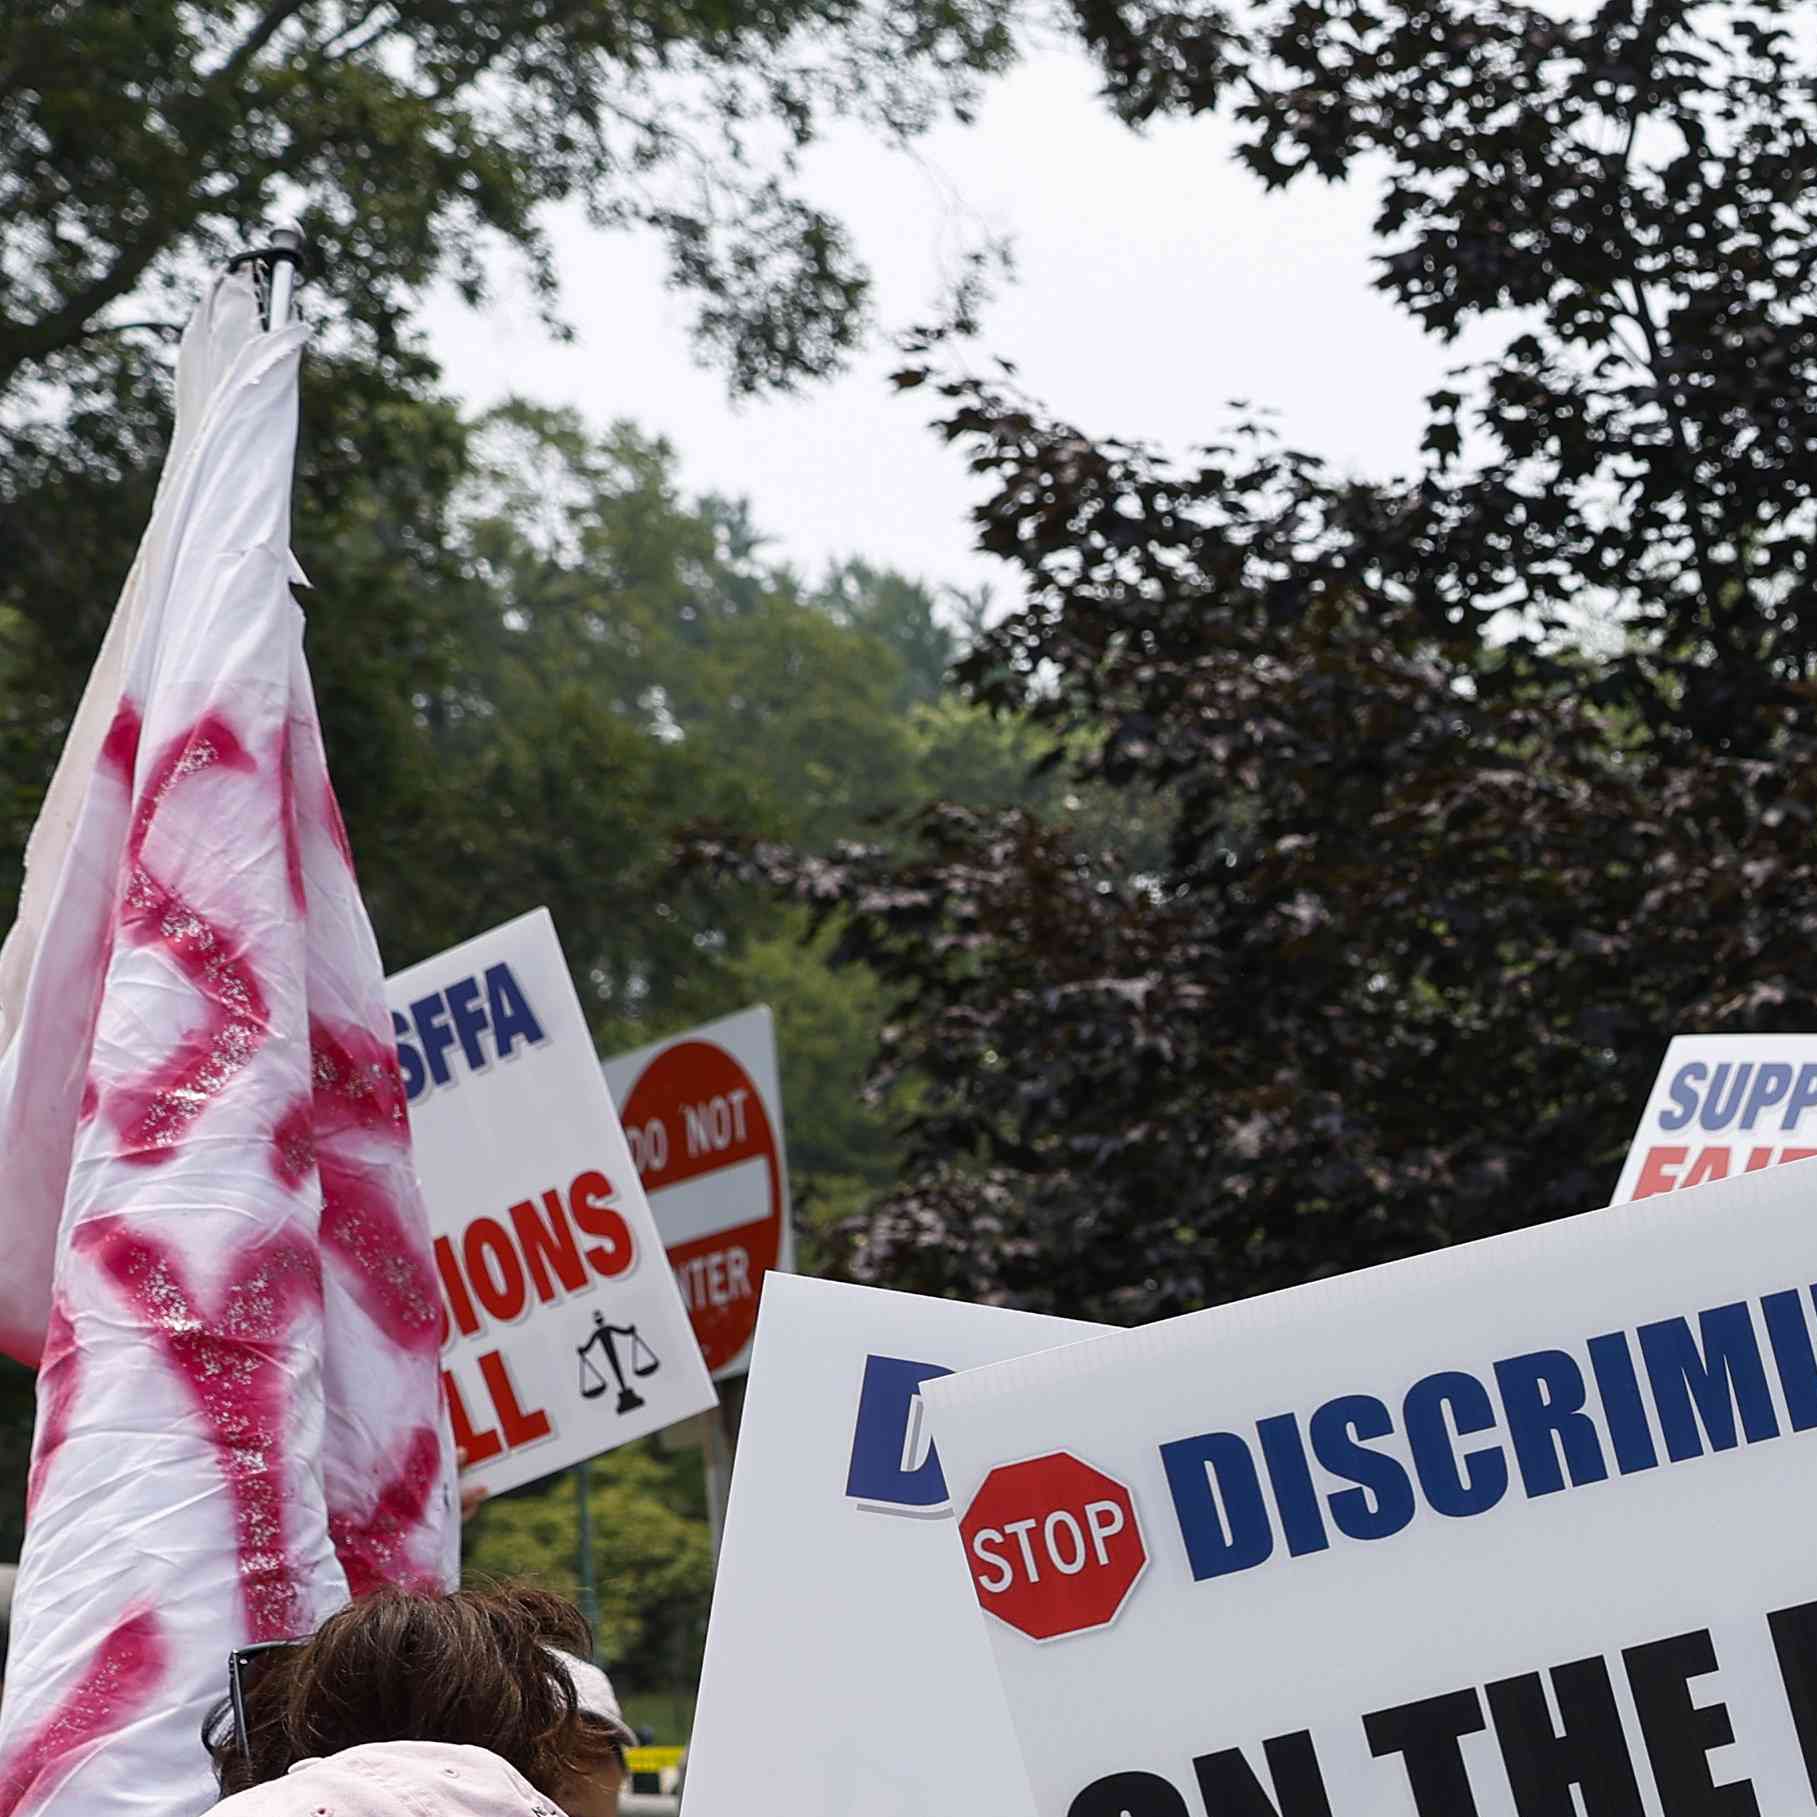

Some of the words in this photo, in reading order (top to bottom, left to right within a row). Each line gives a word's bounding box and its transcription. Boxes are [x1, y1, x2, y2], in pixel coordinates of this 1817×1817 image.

[682, 1089, 751, 1159] NOT
[431, 1170, 634, 1348] IONS
[440, 1349, 552, 1468] LL
[971, 1496, 1124, 1596] STOP
